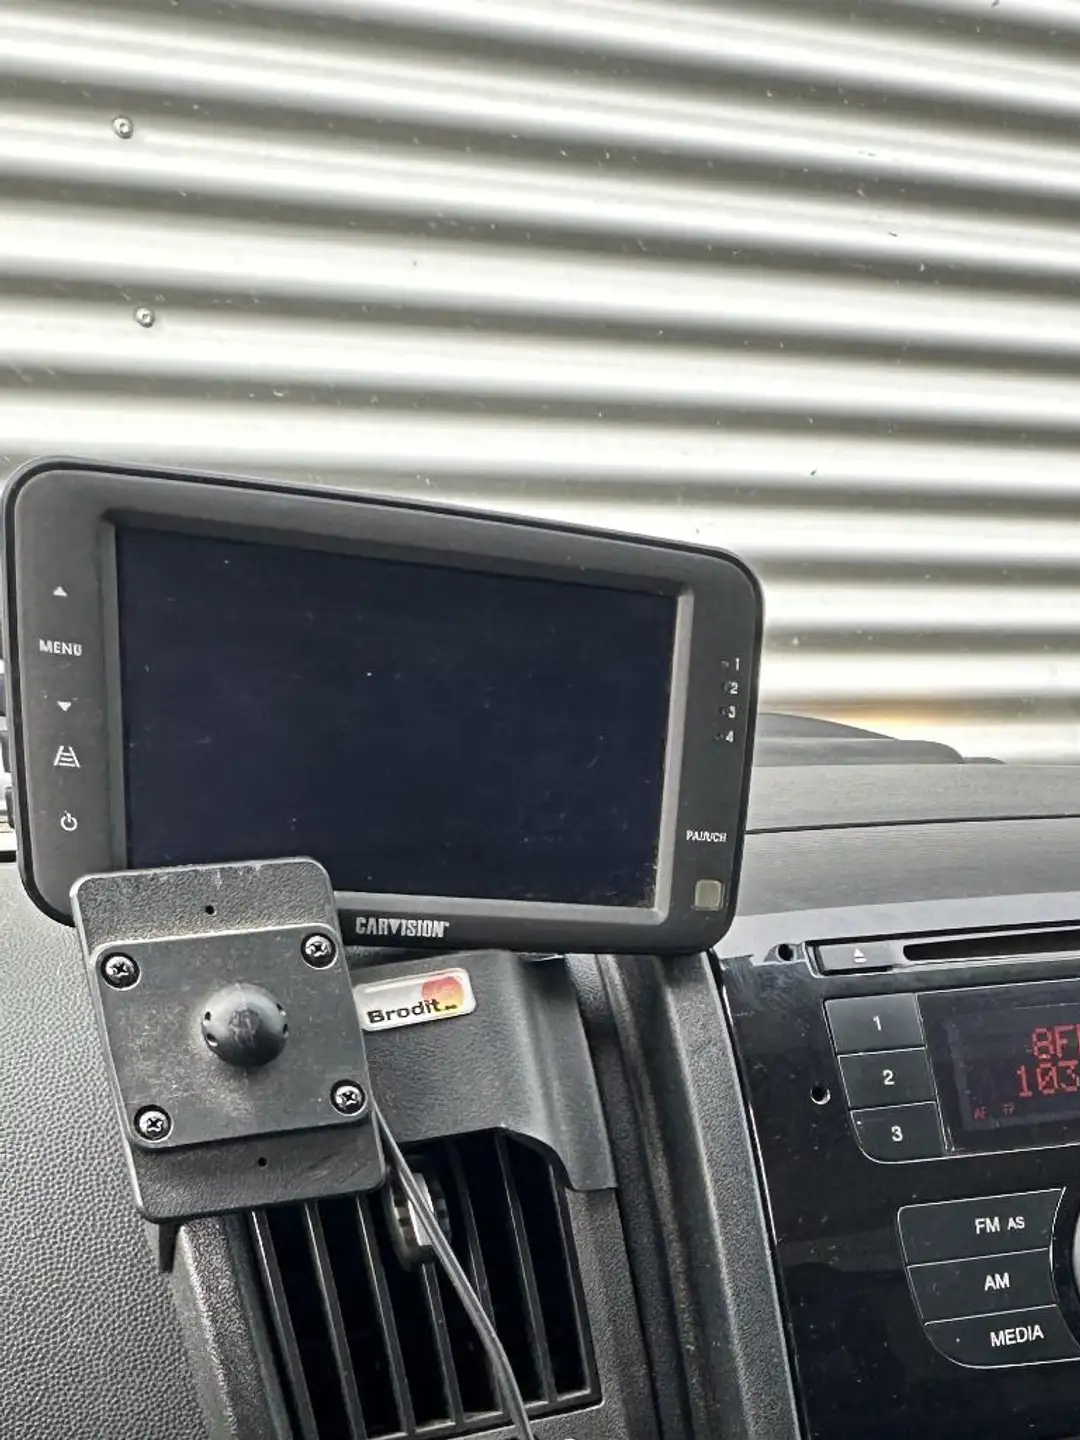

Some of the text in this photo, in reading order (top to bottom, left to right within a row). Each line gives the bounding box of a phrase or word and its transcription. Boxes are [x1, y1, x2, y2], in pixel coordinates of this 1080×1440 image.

[39, 639, 82, 656] MENU
[735, 657, 741, 671] 1
[729, 682, 739, 695] 2
[728, 705, 737, 719] 3
[725, 730, 734, 743] 4
[355, 916, 446, 938] CARVISION
[367, 998, 442, 1024] Brodit
[872, 1015, 882, 1031] 1
[882, 1069, 895, 1086] 2
[891, 1125, 904, 1142] 3
[975, 1216, 1026, 1235] FM AS
[984, 1272, 1010, 1291] AM
[989, 1324, 1045, 1348] MEDIA
